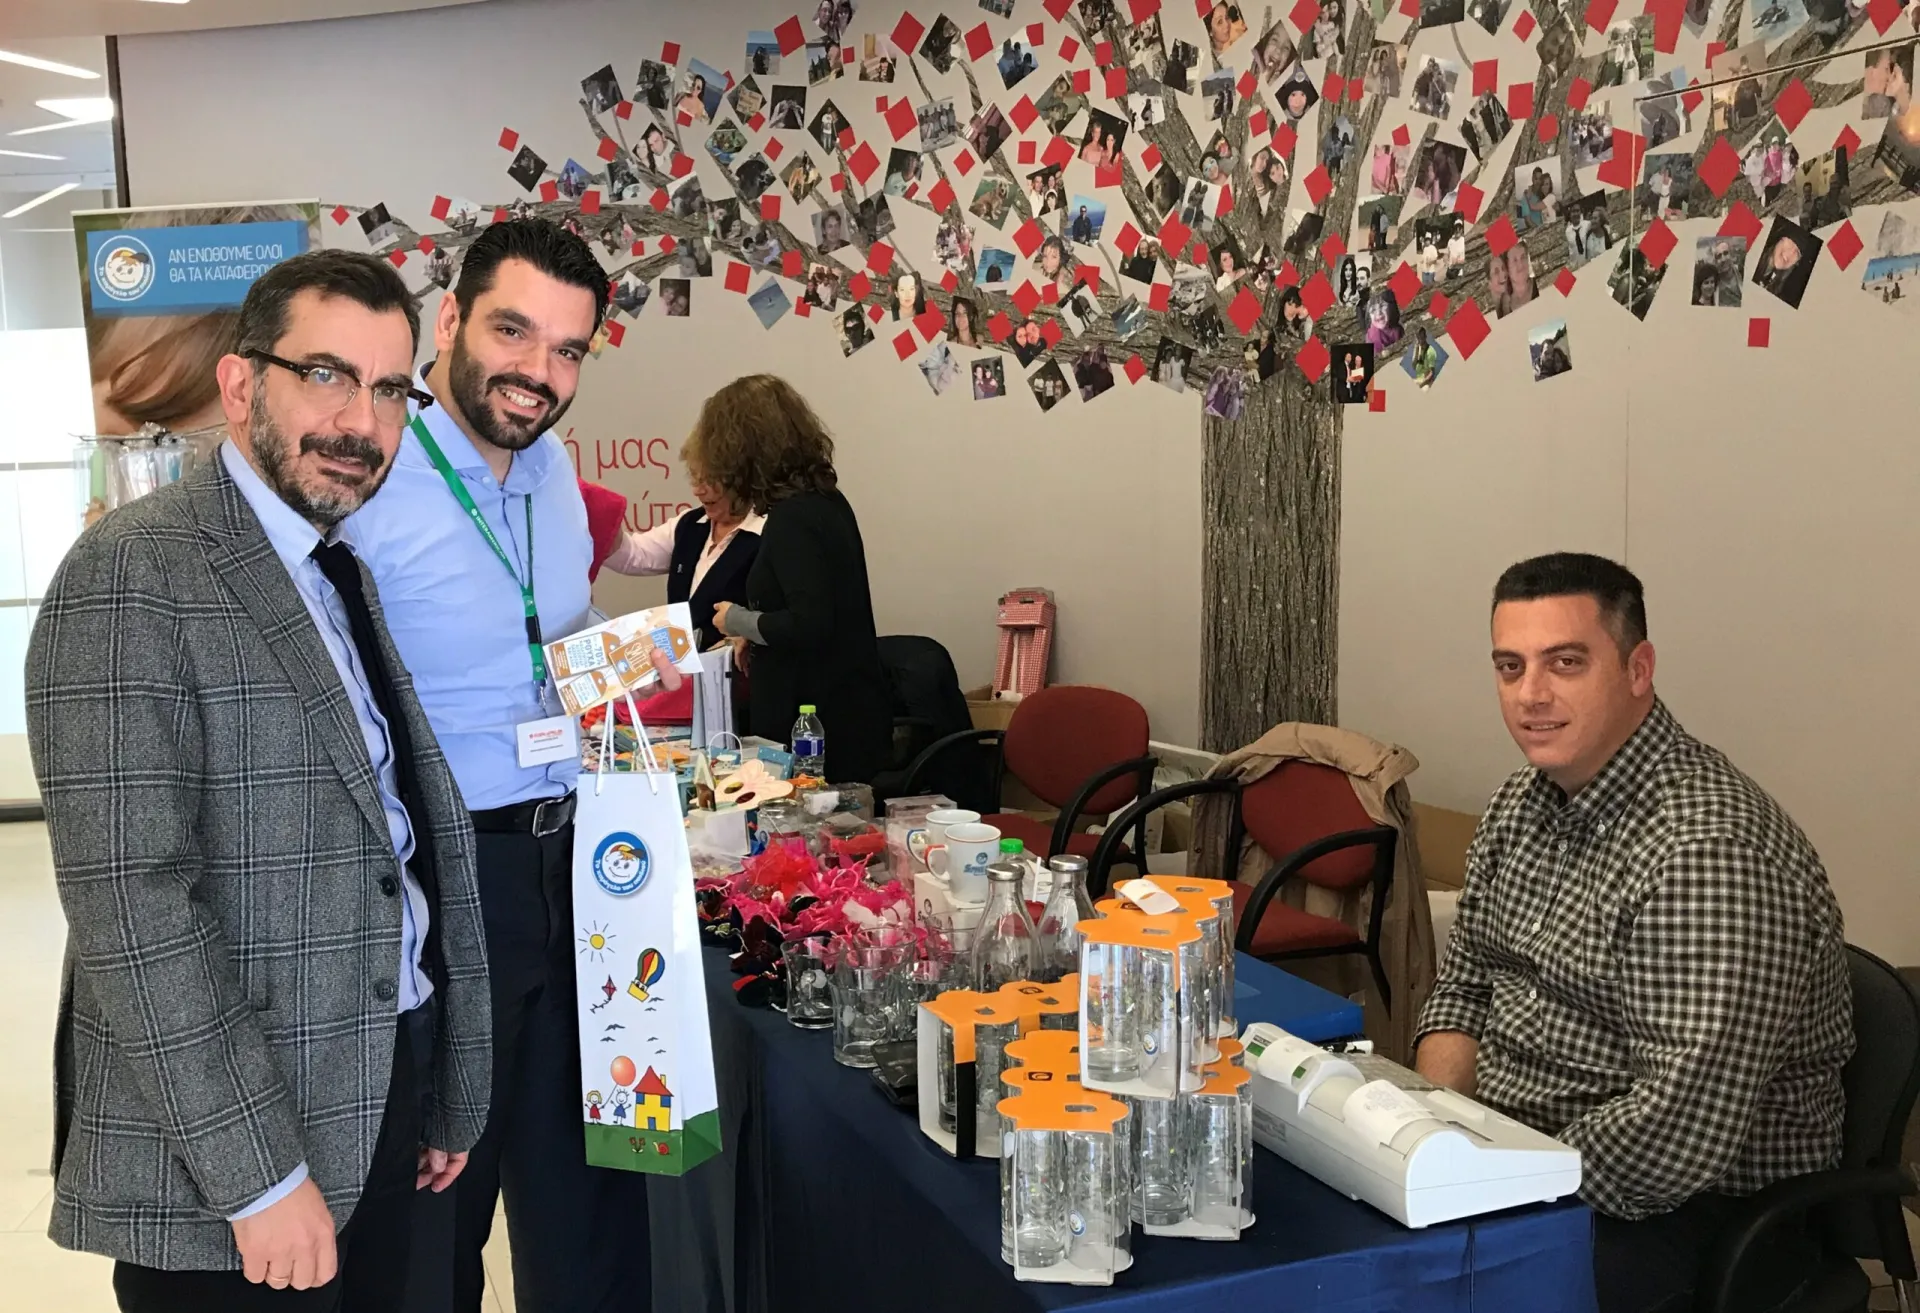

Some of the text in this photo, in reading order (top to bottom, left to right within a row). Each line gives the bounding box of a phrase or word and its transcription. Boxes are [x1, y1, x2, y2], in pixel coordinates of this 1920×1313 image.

[168, 244, 283, 264] ΑΝ ΕΝΩΘΟΥΜΕ ΟΛΟΙ
[169, 263, 277, 283] ΘΑ ΤΑ ΚΑΤΑΦΕΡΟ
[596, 437, 670, 480] μας
